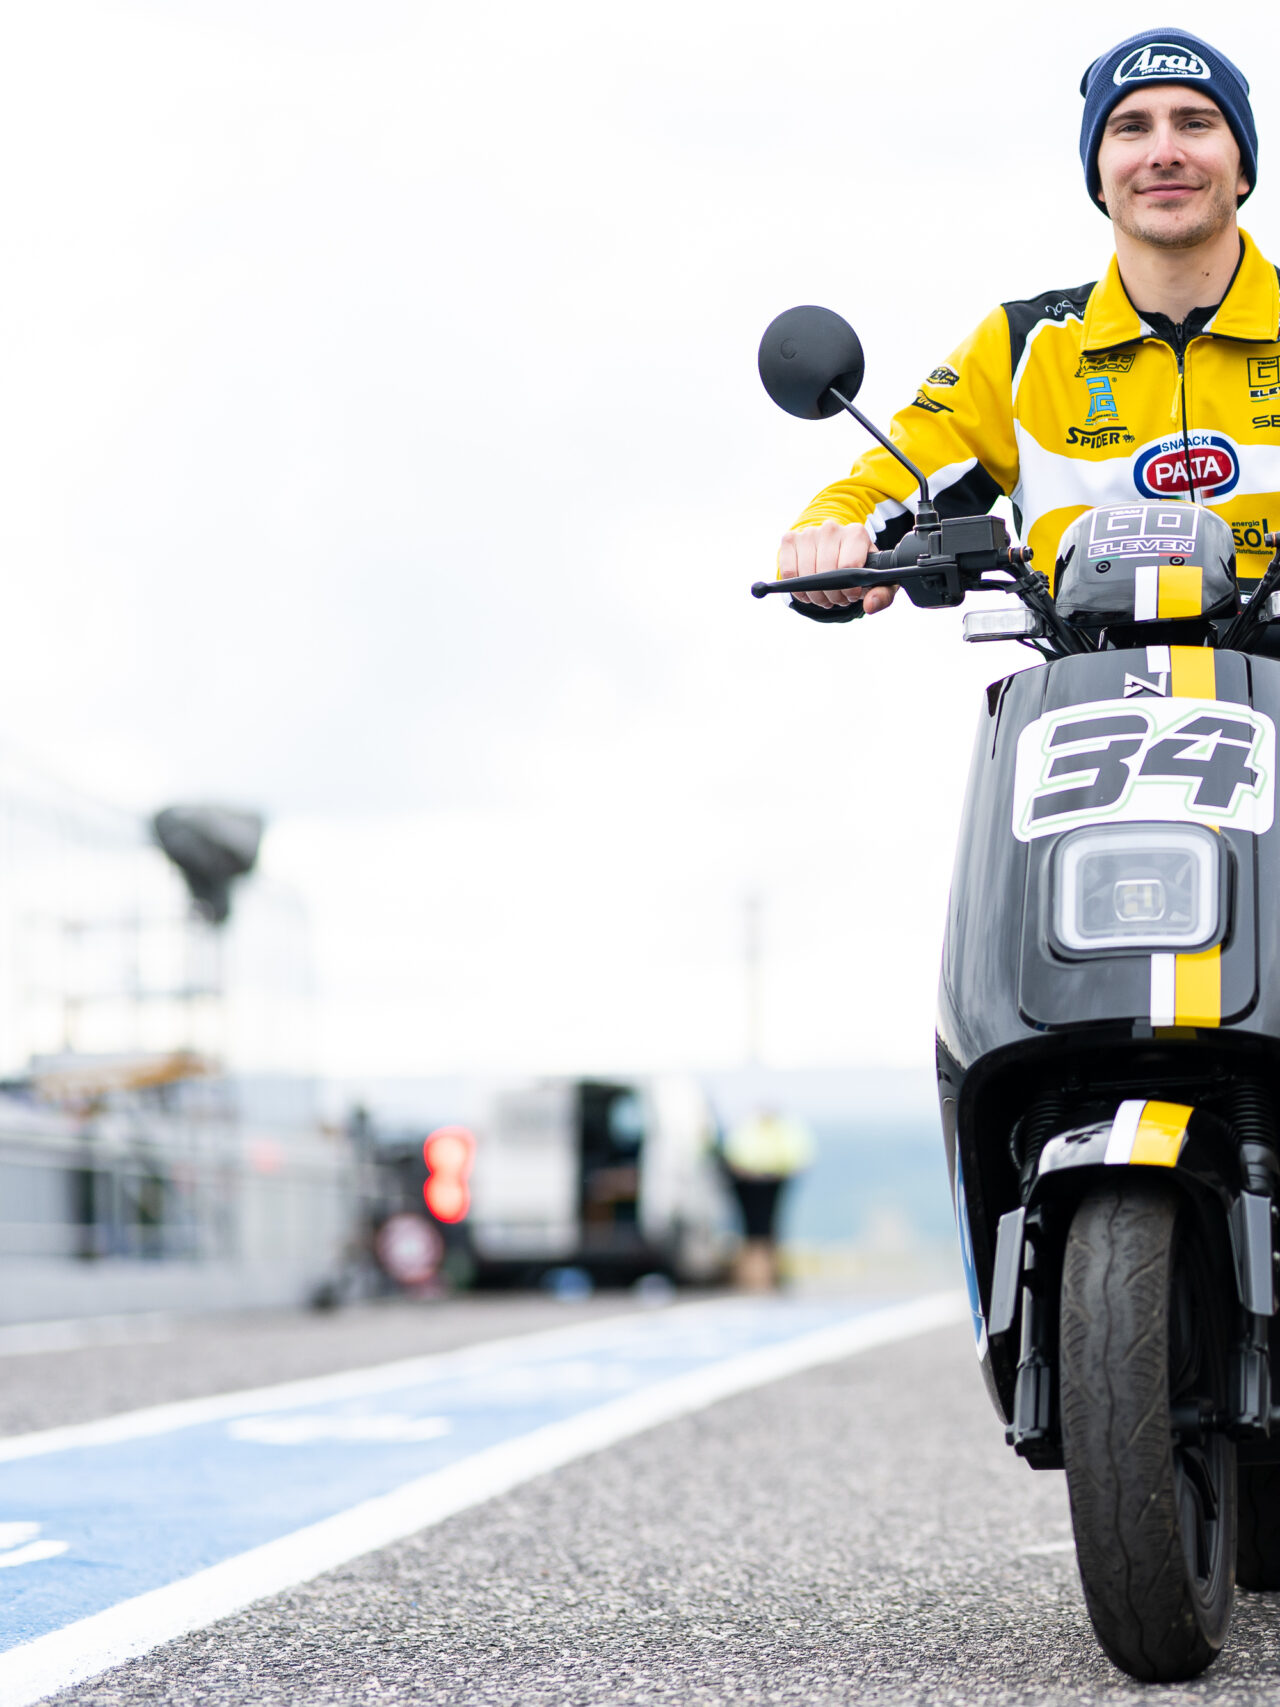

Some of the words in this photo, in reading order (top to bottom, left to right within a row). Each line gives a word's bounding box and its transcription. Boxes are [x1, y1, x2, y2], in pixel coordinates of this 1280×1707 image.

[1128, 48, 1201, 76] Arai
[1066, 426, 1128, 449] SPIDER
[1154, 455, 1223, 487] PATA
[1087, 539, 1197, 559] ELEVEN
[1030, 713, 1260, 822] 34
